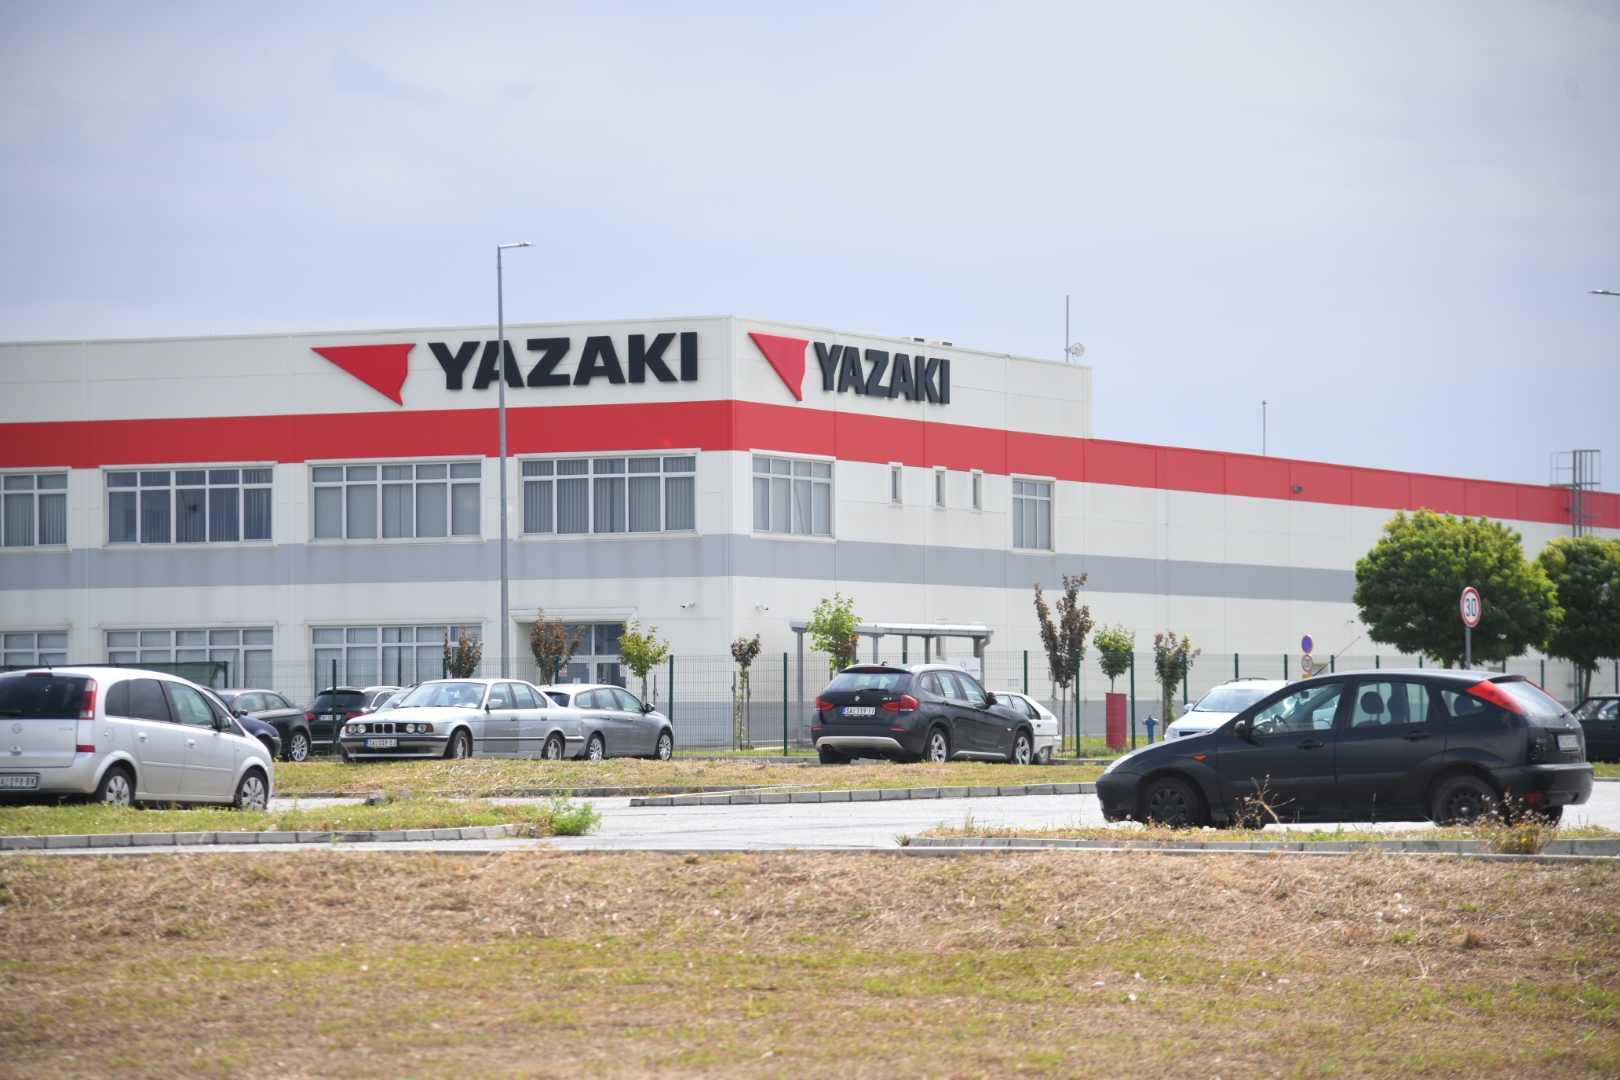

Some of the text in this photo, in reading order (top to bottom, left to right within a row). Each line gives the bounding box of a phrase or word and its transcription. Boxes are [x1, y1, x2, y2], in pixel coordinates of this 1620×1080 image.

[427, 331, 697, 390] YAZAKI
[814, 341, 950, 405] YAZAKI
[1465, 598, 1477, 617] 30
[1304, 658, 1310, 668] 20
